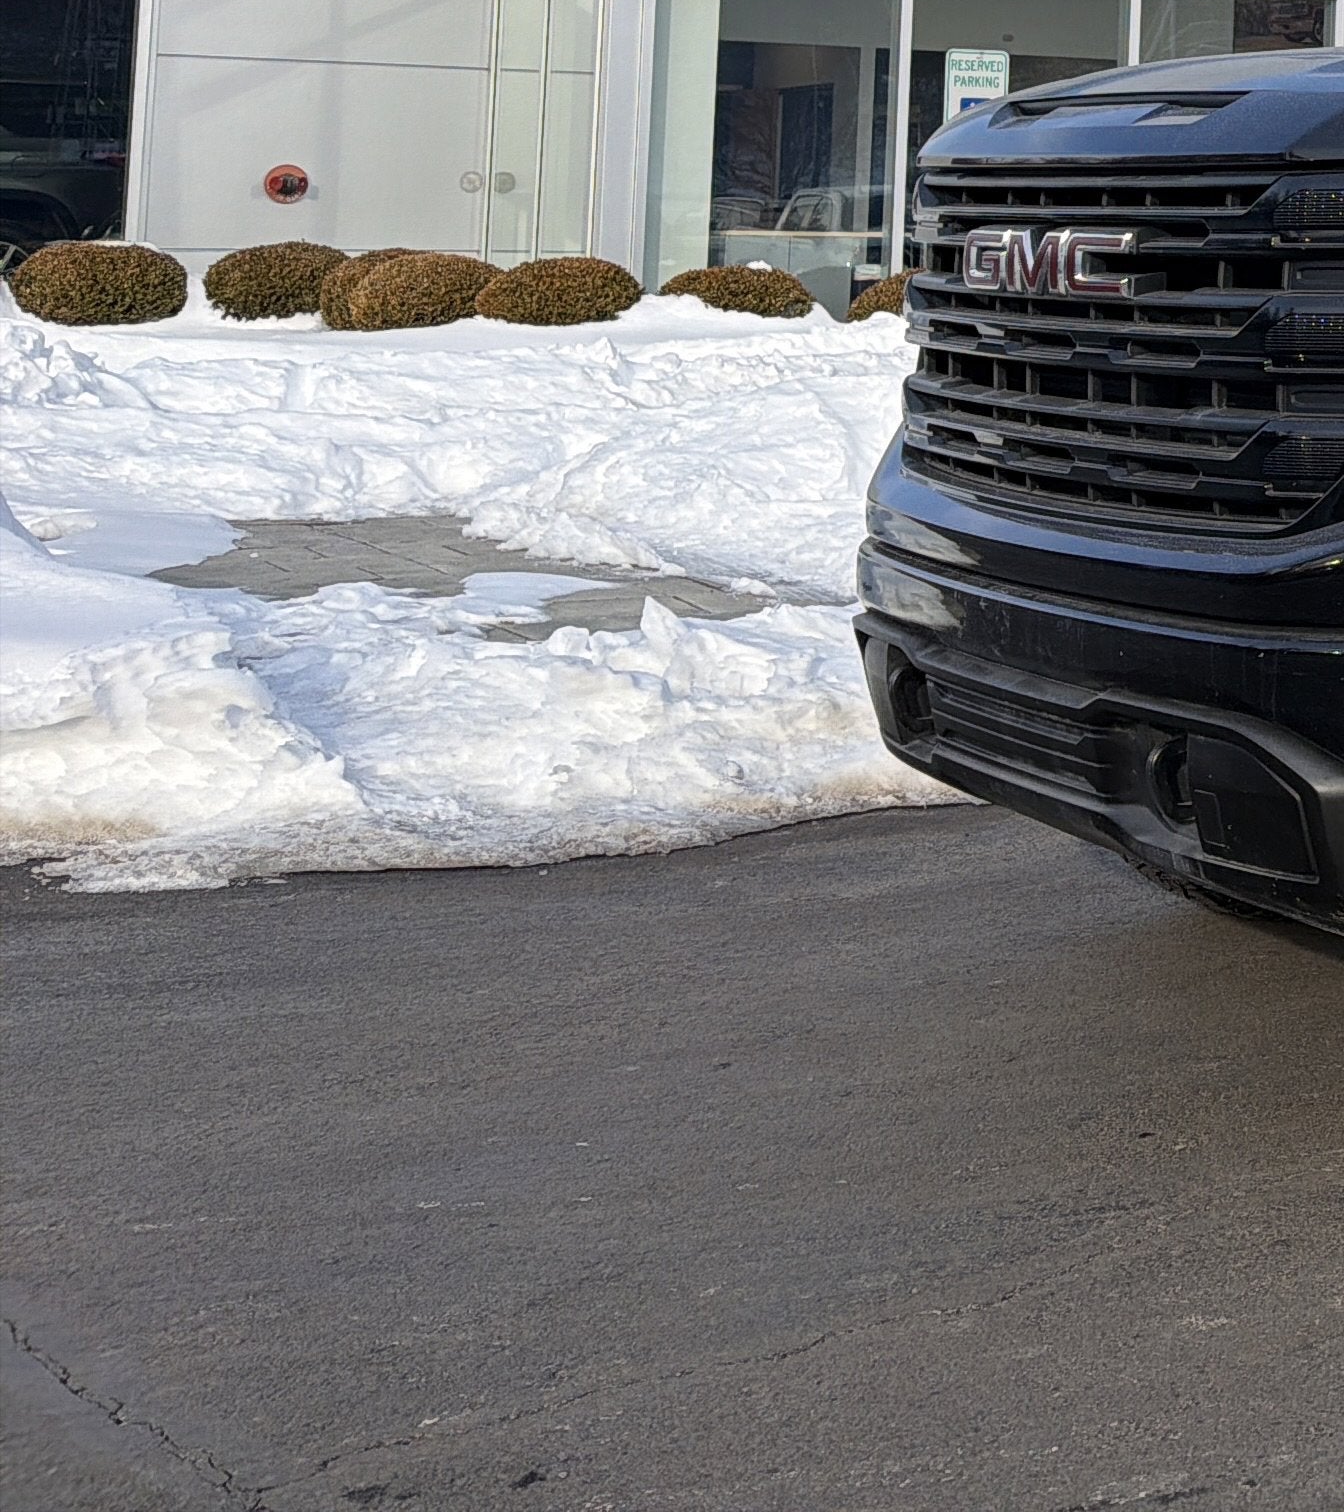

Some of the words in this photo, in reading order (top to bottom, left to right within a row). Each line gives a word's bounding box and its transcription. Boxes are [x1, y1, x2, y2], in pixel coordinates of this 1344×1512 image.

[950, 59, 1004, 73] RESERVED
[953, 75, 1000, 89] PARKING
[963, 225, 1138, 298] GMC
